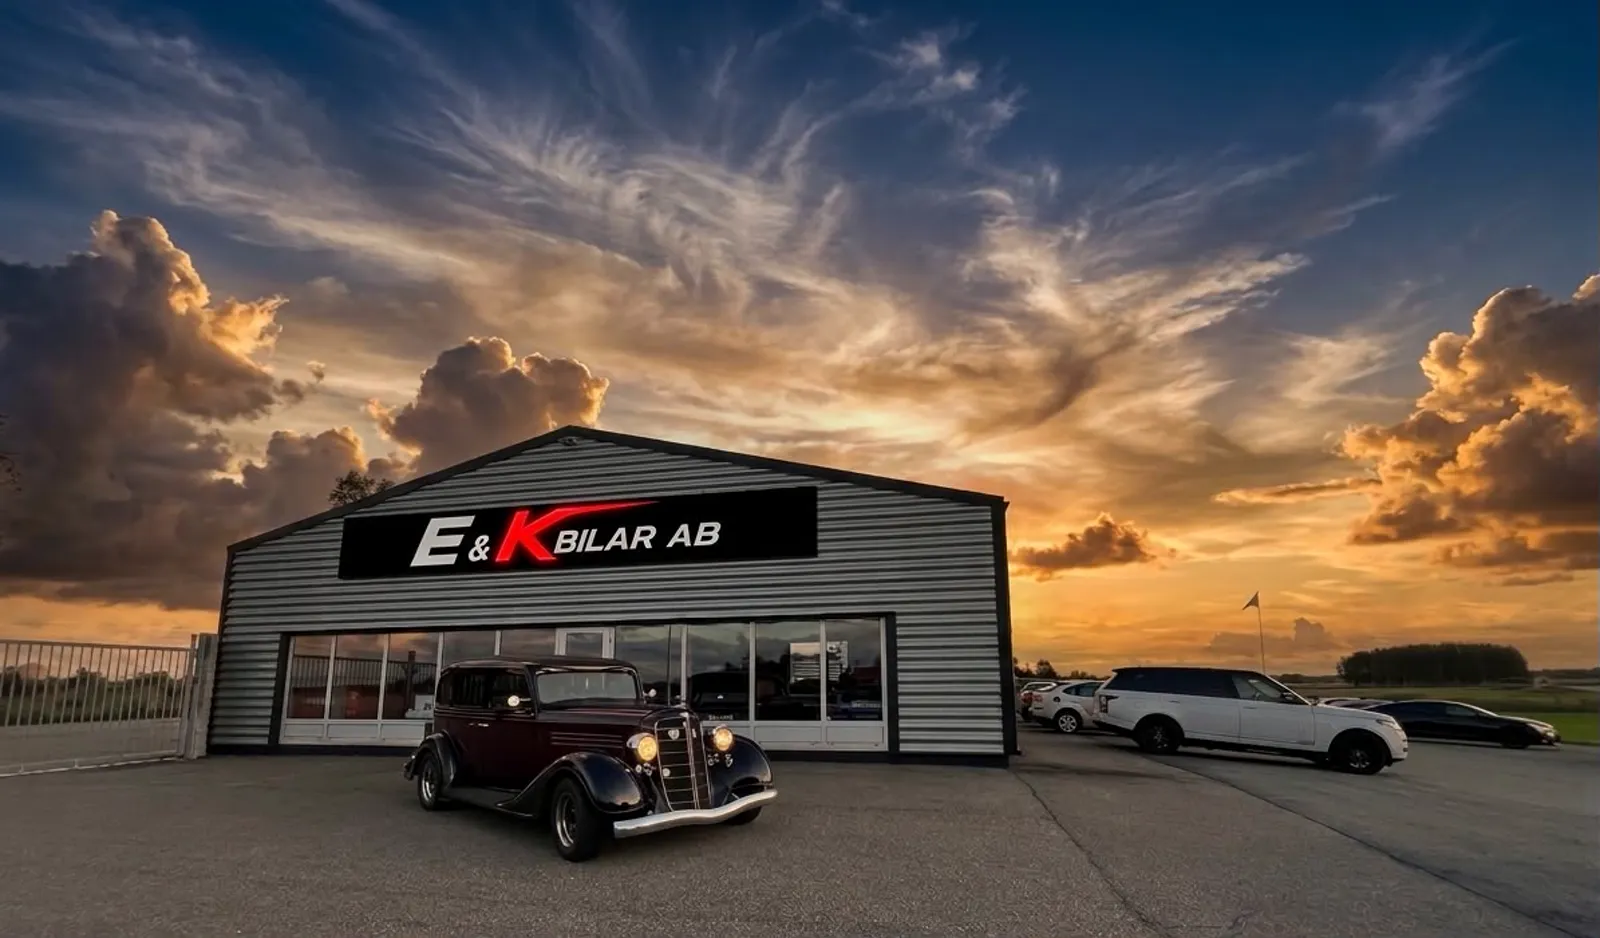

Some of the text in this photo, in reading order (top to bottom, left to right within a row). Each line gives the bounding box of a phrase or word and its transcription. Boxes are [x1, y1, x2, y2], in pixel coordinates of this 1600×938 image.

[410, 501, 721, 566] E & K BILAR AB
